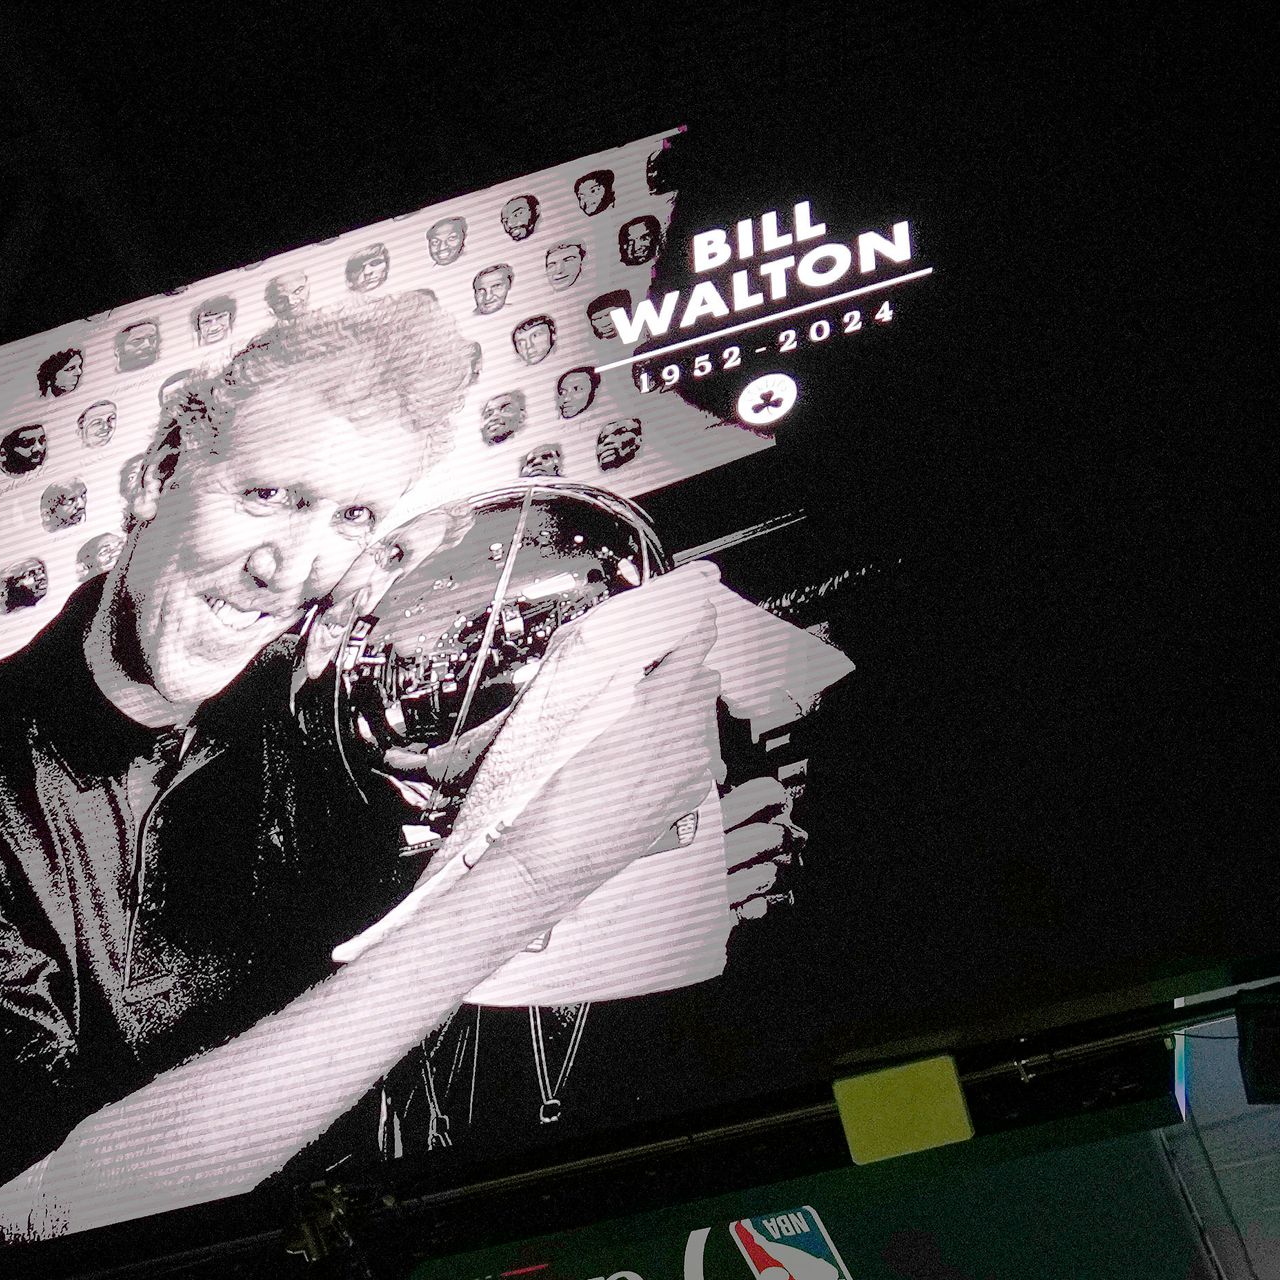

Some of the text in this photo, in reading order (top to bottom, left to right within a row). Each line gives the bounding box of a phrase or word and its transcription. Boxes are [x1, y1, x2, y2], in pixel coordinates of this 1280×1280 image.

[692, 200, 826, 273] BILL
[609, 220, 912, 346] WALTON
[638, 300, 894, 395] 1952-2024
[763, 1211, 810, 1241] NBA
